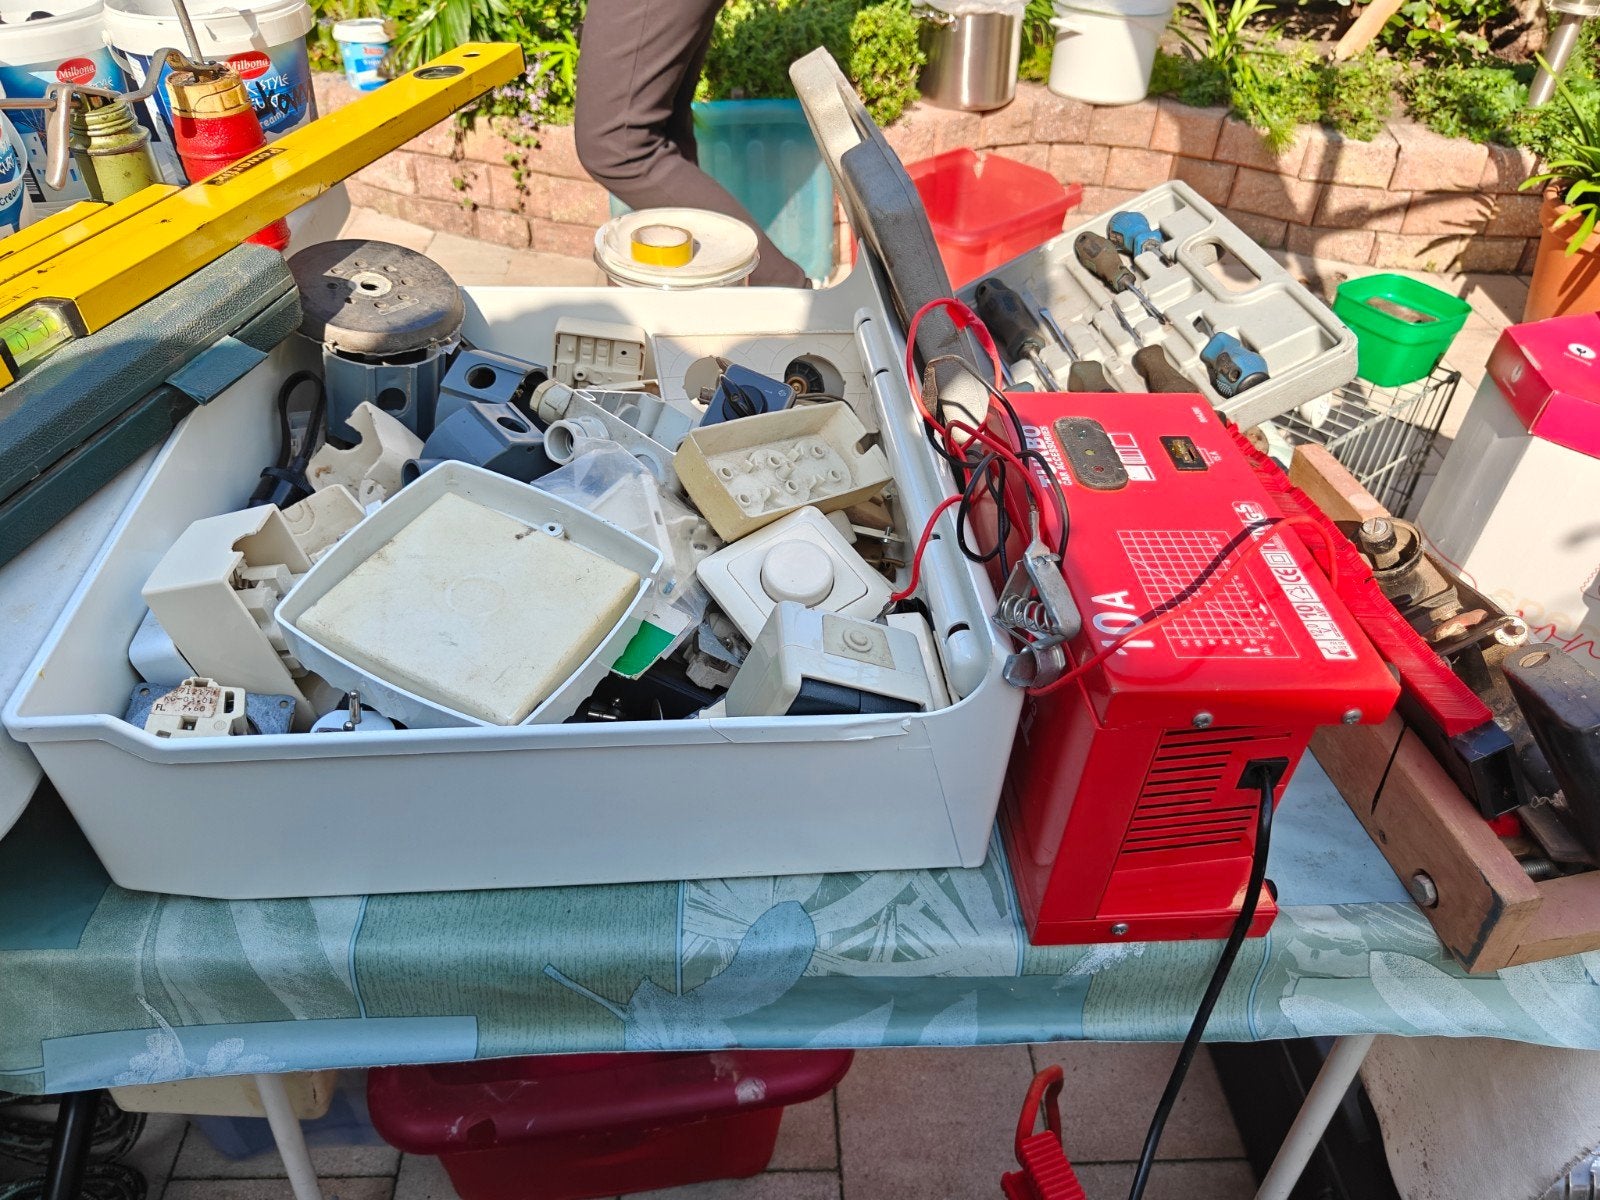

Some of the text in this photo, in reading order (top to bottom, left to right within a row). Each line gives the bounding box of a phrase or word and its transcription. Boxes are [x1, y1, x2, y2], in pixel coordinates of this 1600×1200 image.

[58, 64, 95, 80] Milbona
[1296, 605, 1317, 618] 10
[1091, 590, 1155, 656] 10A
